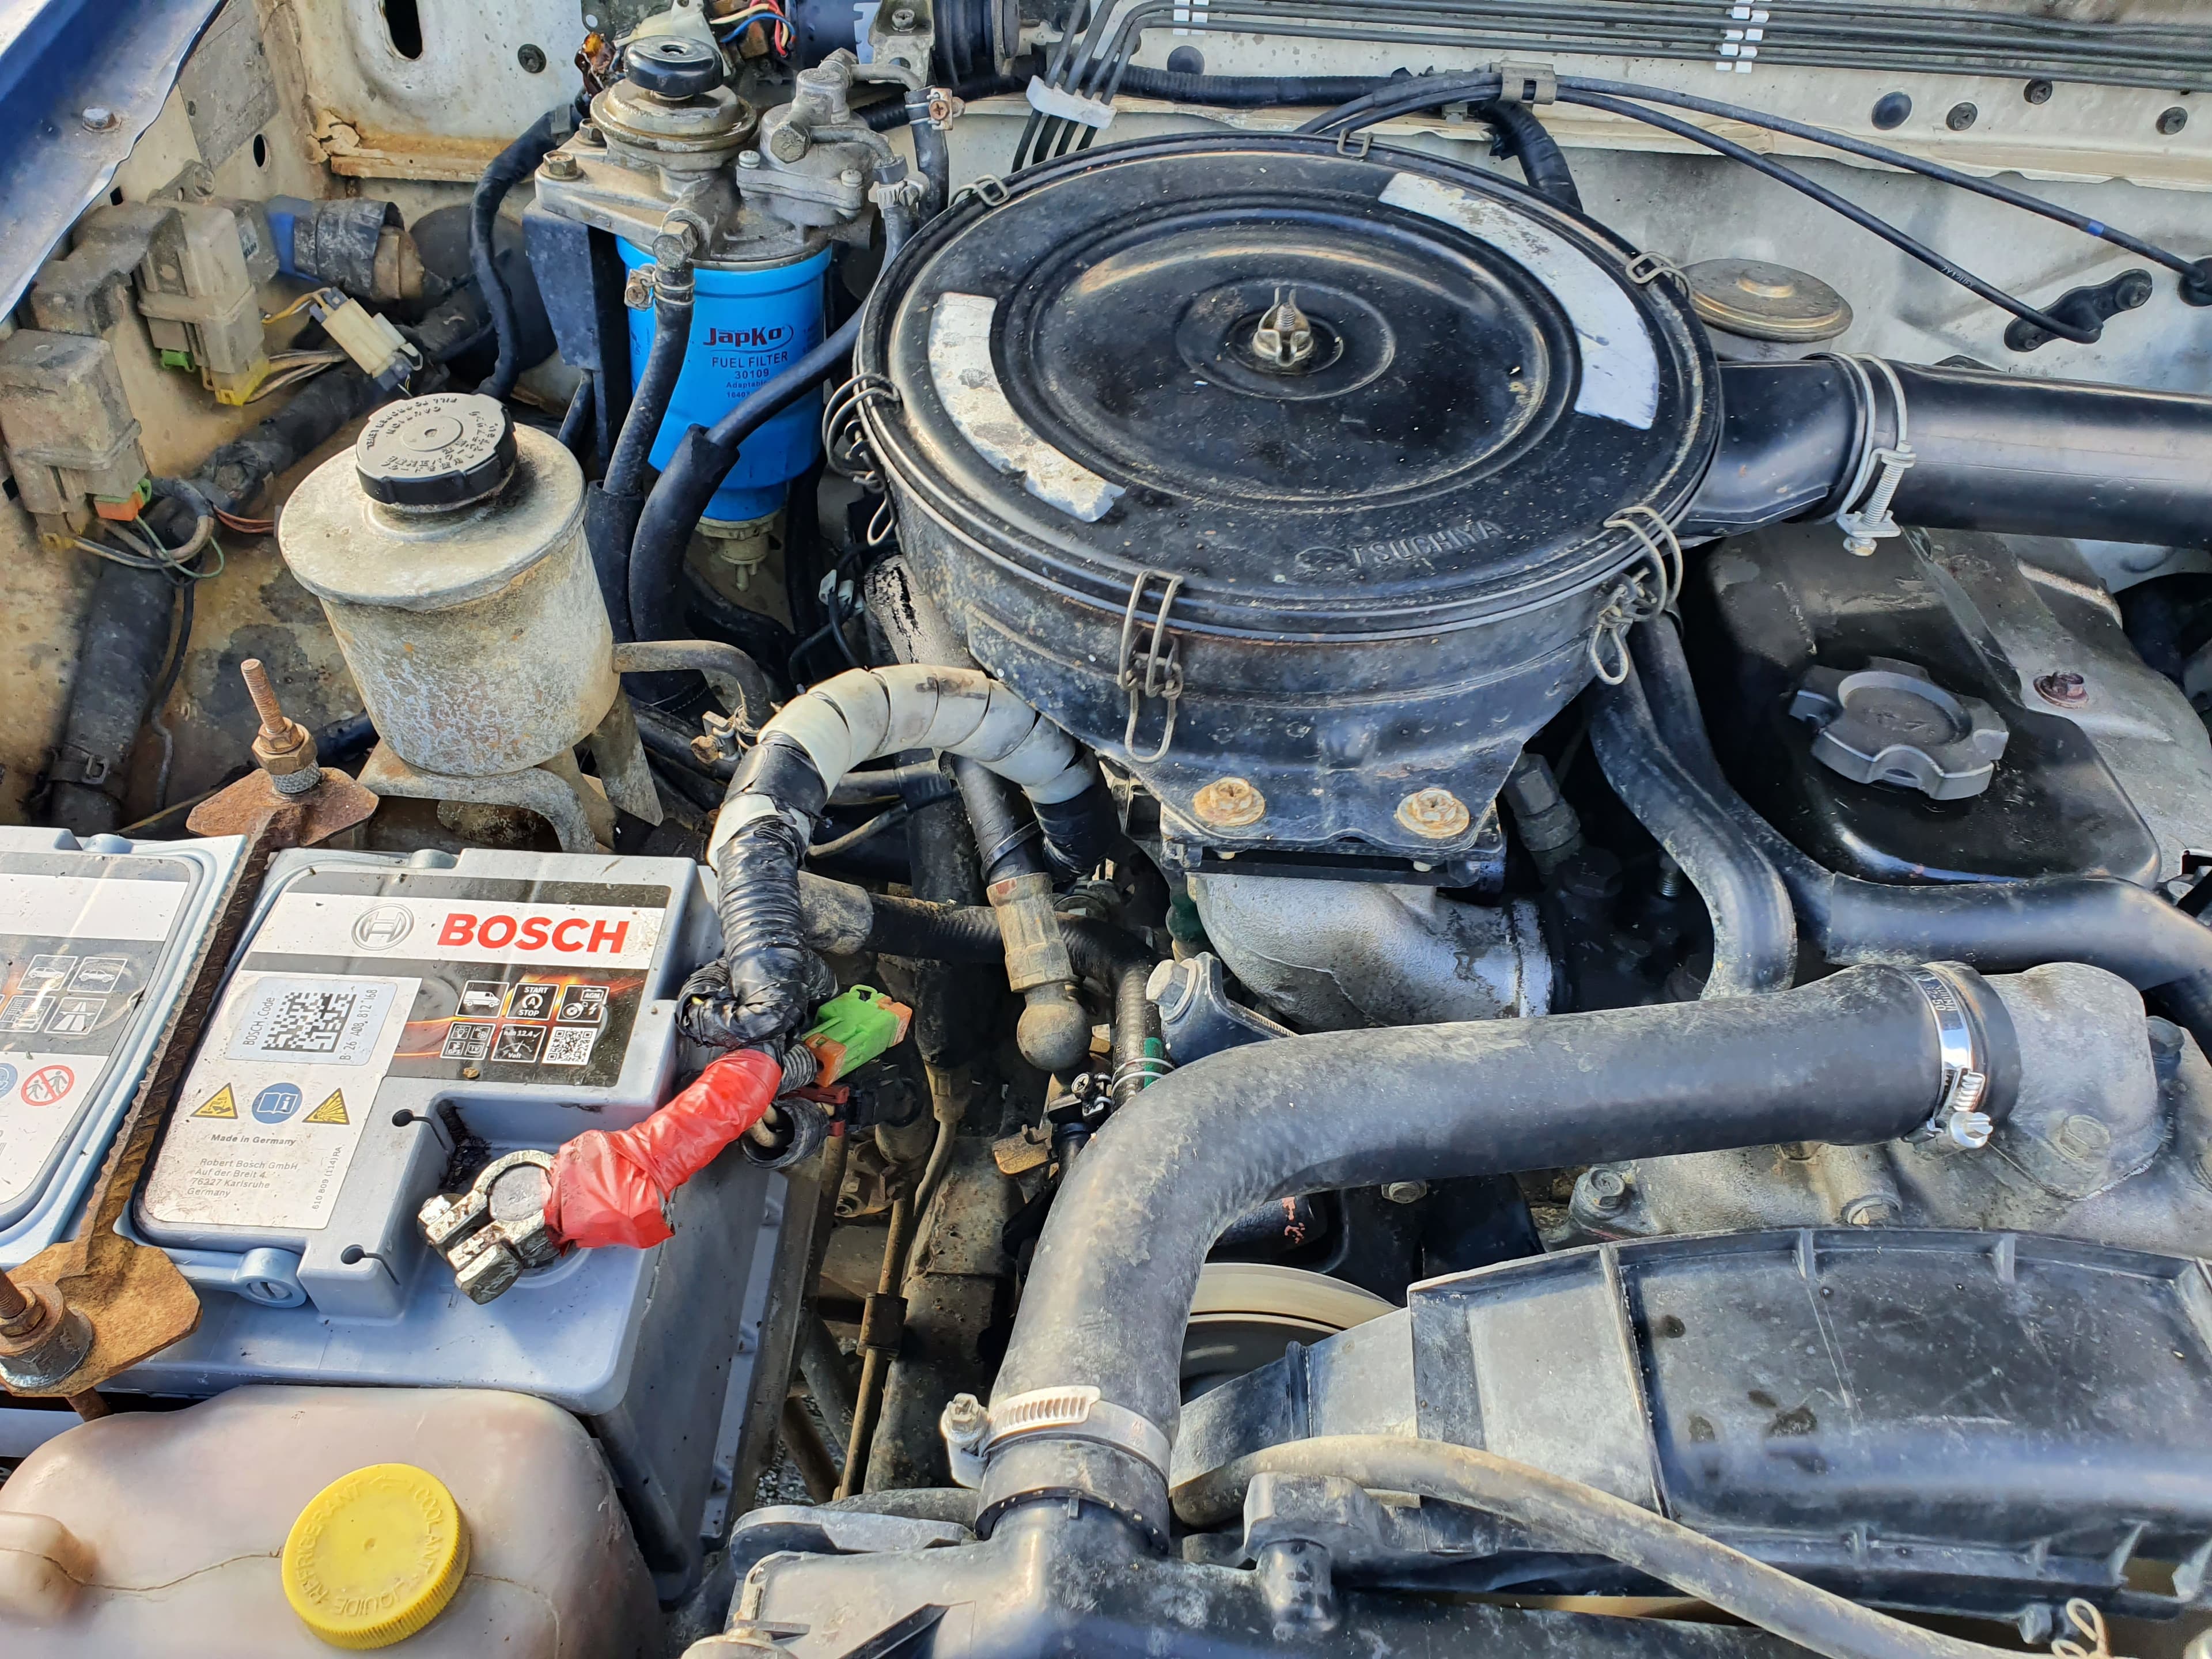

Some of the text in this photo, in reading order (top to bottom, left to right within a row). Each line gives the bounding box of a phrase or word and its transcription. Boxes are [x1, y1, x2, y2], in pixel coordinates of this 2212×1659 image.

[703, 327, 782, 347] JapKo
[712, 351, 788, 368] FUEL FILTER
[735, 368, 770, 379] 30109
[366, 429, 379, 450] LEVEL
[1352, 520, 1505, 566] TSUCHIYA
[437, 913, 630, 953] BOSCH
[363, 989, 378, 1000] 168
[357, 1005, 372, 1018] 812
[343, 1041, 357, 1050] 26
[211, 1134, 238, 1142] Made
[252, 1137, 297, 1146] Germany
[200, 1158, 298, 1171] Robert Bosch GmbH
[195, 1168, 213, 1176] Auf
[214, 1169, 230, 1177] der
[233, 1170, 257, 1179] Breit
[191, 1177, 270, 1189] 76227 Karlsruhe
[187, 1188, 230, 1198] Germany
[312, 1195, 323, 1209] 610
[318, 1179, 329, 1194] 809
[413, 1487, 444, 1574] COOLANT
